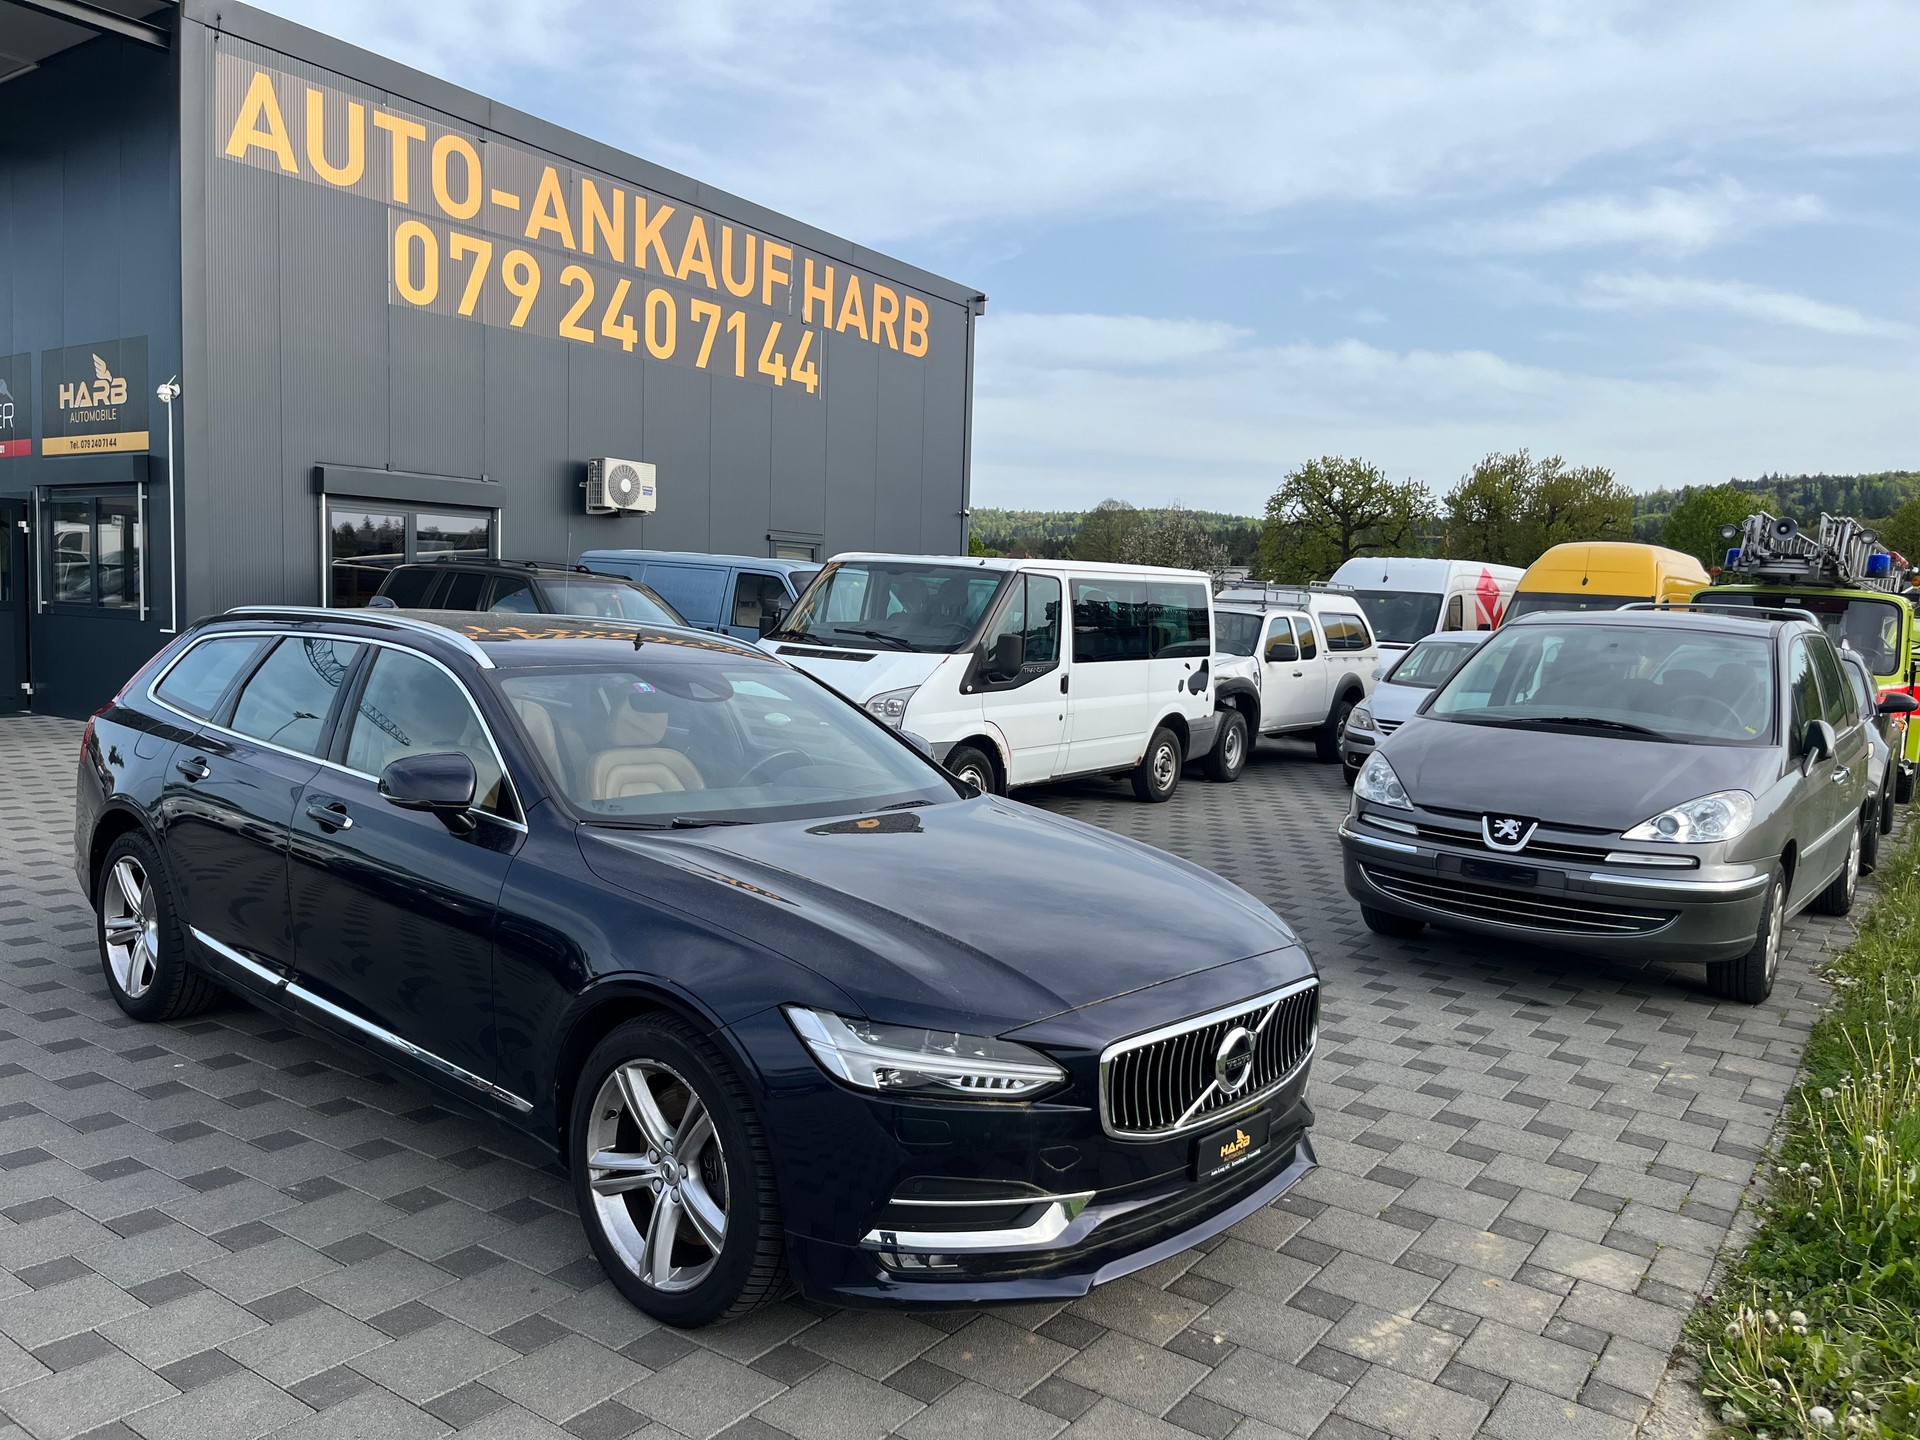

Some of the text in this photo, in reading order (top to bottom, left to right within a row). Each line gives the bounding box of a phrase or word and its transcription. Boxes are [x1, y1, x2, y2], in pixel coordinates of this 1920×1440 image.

[225, 71, 929, 358] AUTO-ANKAUF HARB
[394, 220, 541, 328] 079
[559, 265, 677, 360] 240
[59, 377, 128, 410] HARB
[69, 408, 117, 423] AUTOMOBILE
[1226, 1054, 1251, 1068] VOLVO
[1220, 1134, 1250, 1157] HARB
